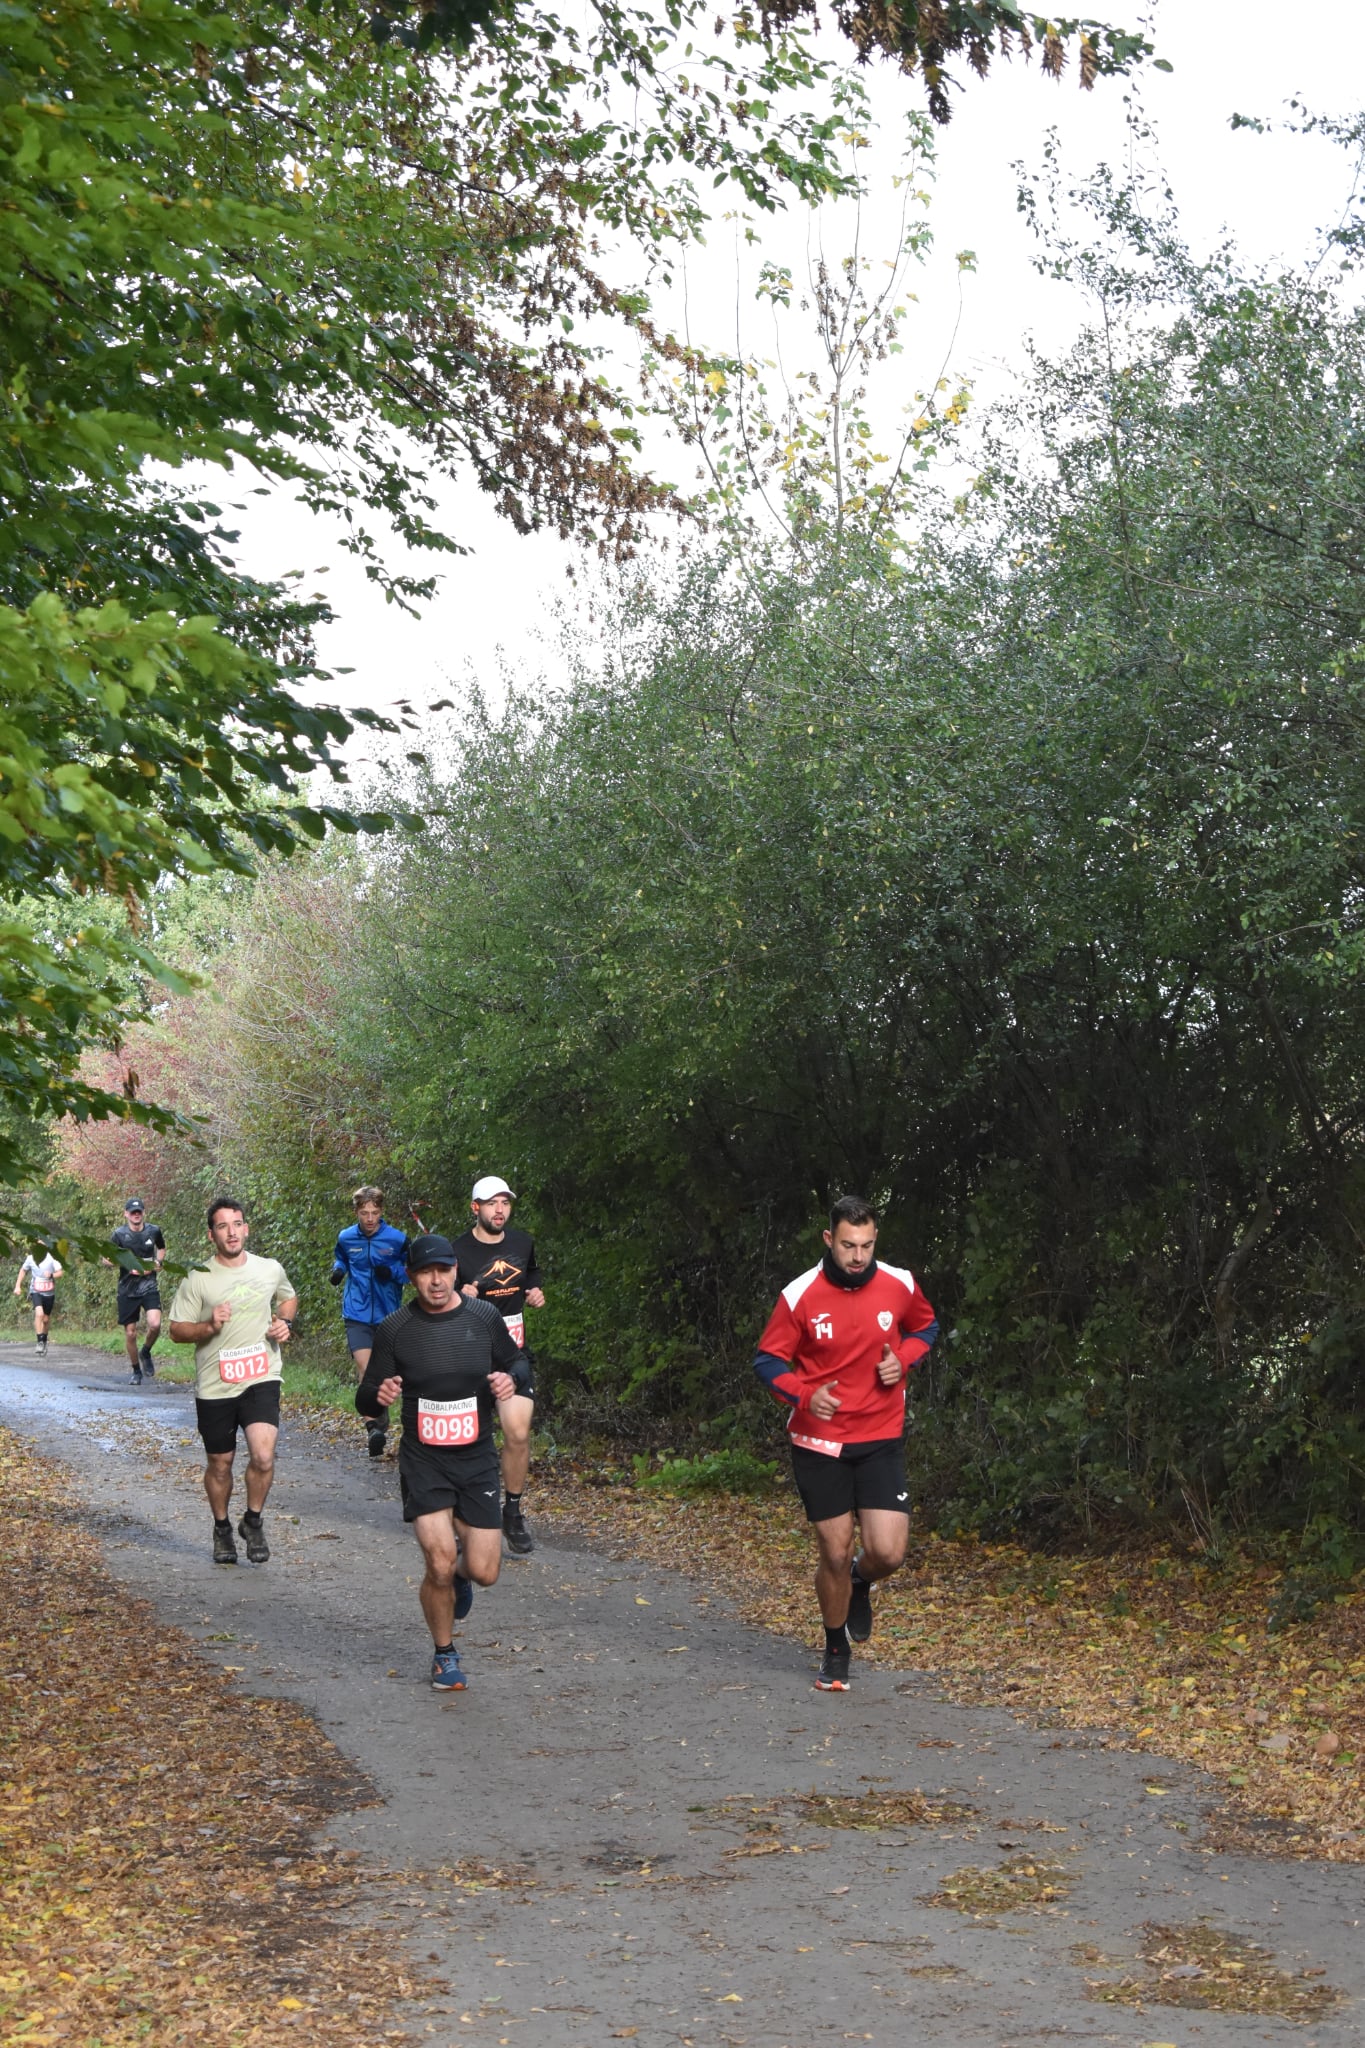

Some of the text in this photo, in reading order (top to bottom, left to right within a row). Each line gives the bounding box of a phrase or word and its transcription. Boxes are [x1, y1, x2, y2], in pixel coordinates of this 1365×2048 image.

[815, 1322, 833, 1339] 14
[224, 1356, 266, 1379] 8012
[423, 1400, 473, 1411] GLOBALPACING
[422, 1415, 475, 1440] 8098
